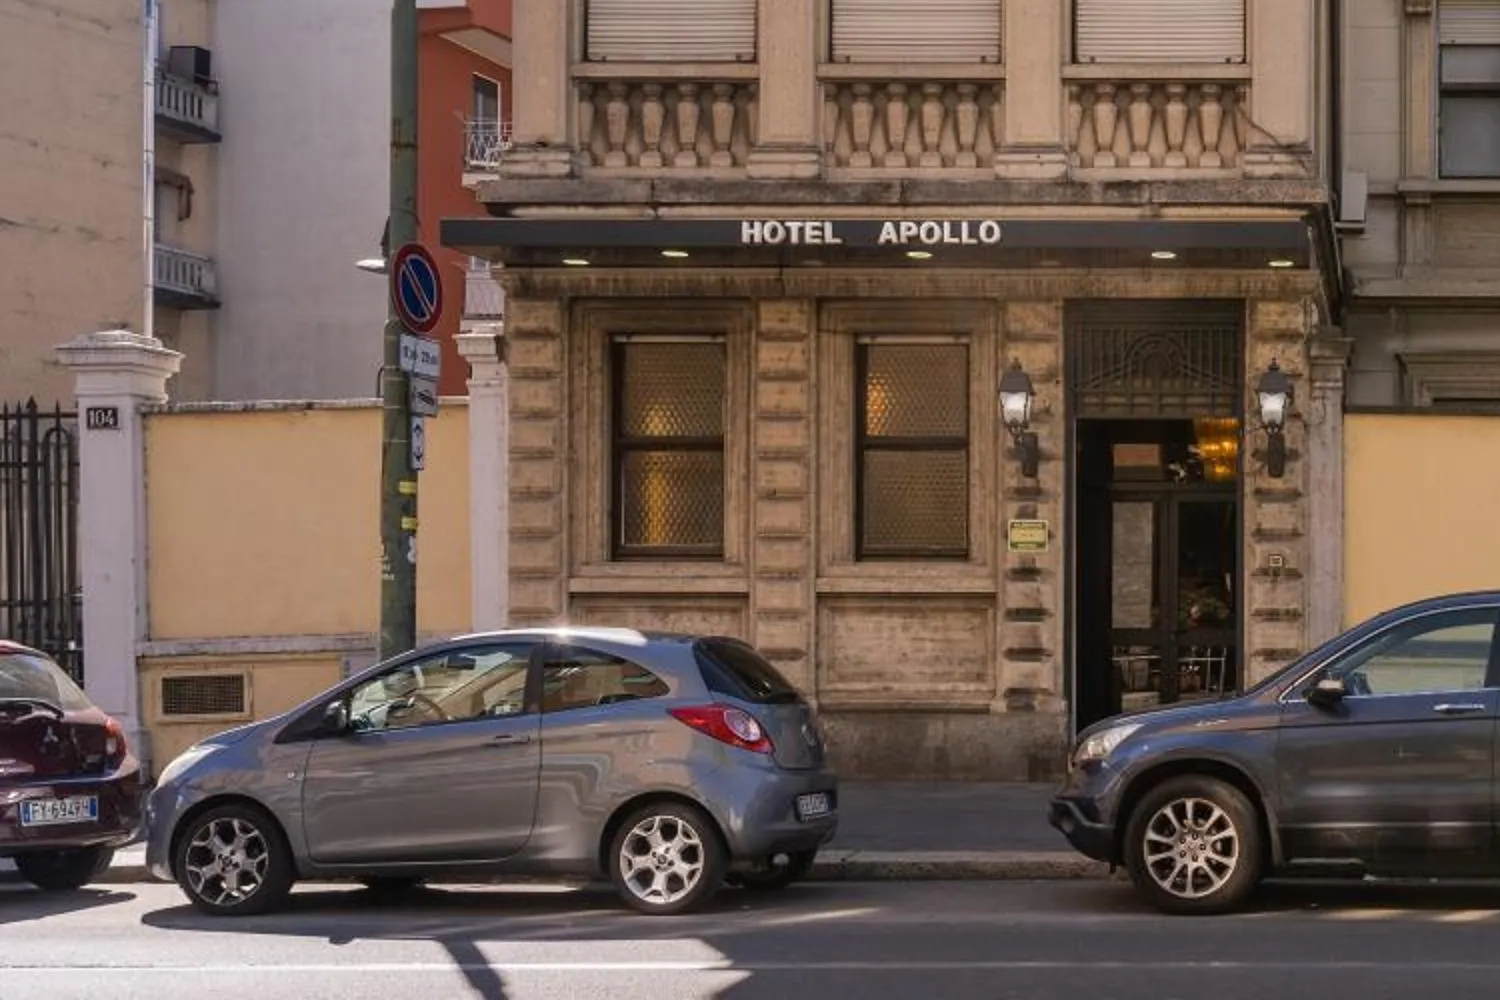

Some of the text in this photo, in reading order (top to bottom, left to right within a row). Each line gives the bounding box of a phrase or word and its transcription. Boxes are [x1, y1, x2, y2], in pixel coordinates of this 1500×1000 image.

[741, 221, 1002, 244] HOTEL APOLLO
[89, 409, 113, 425] 104
